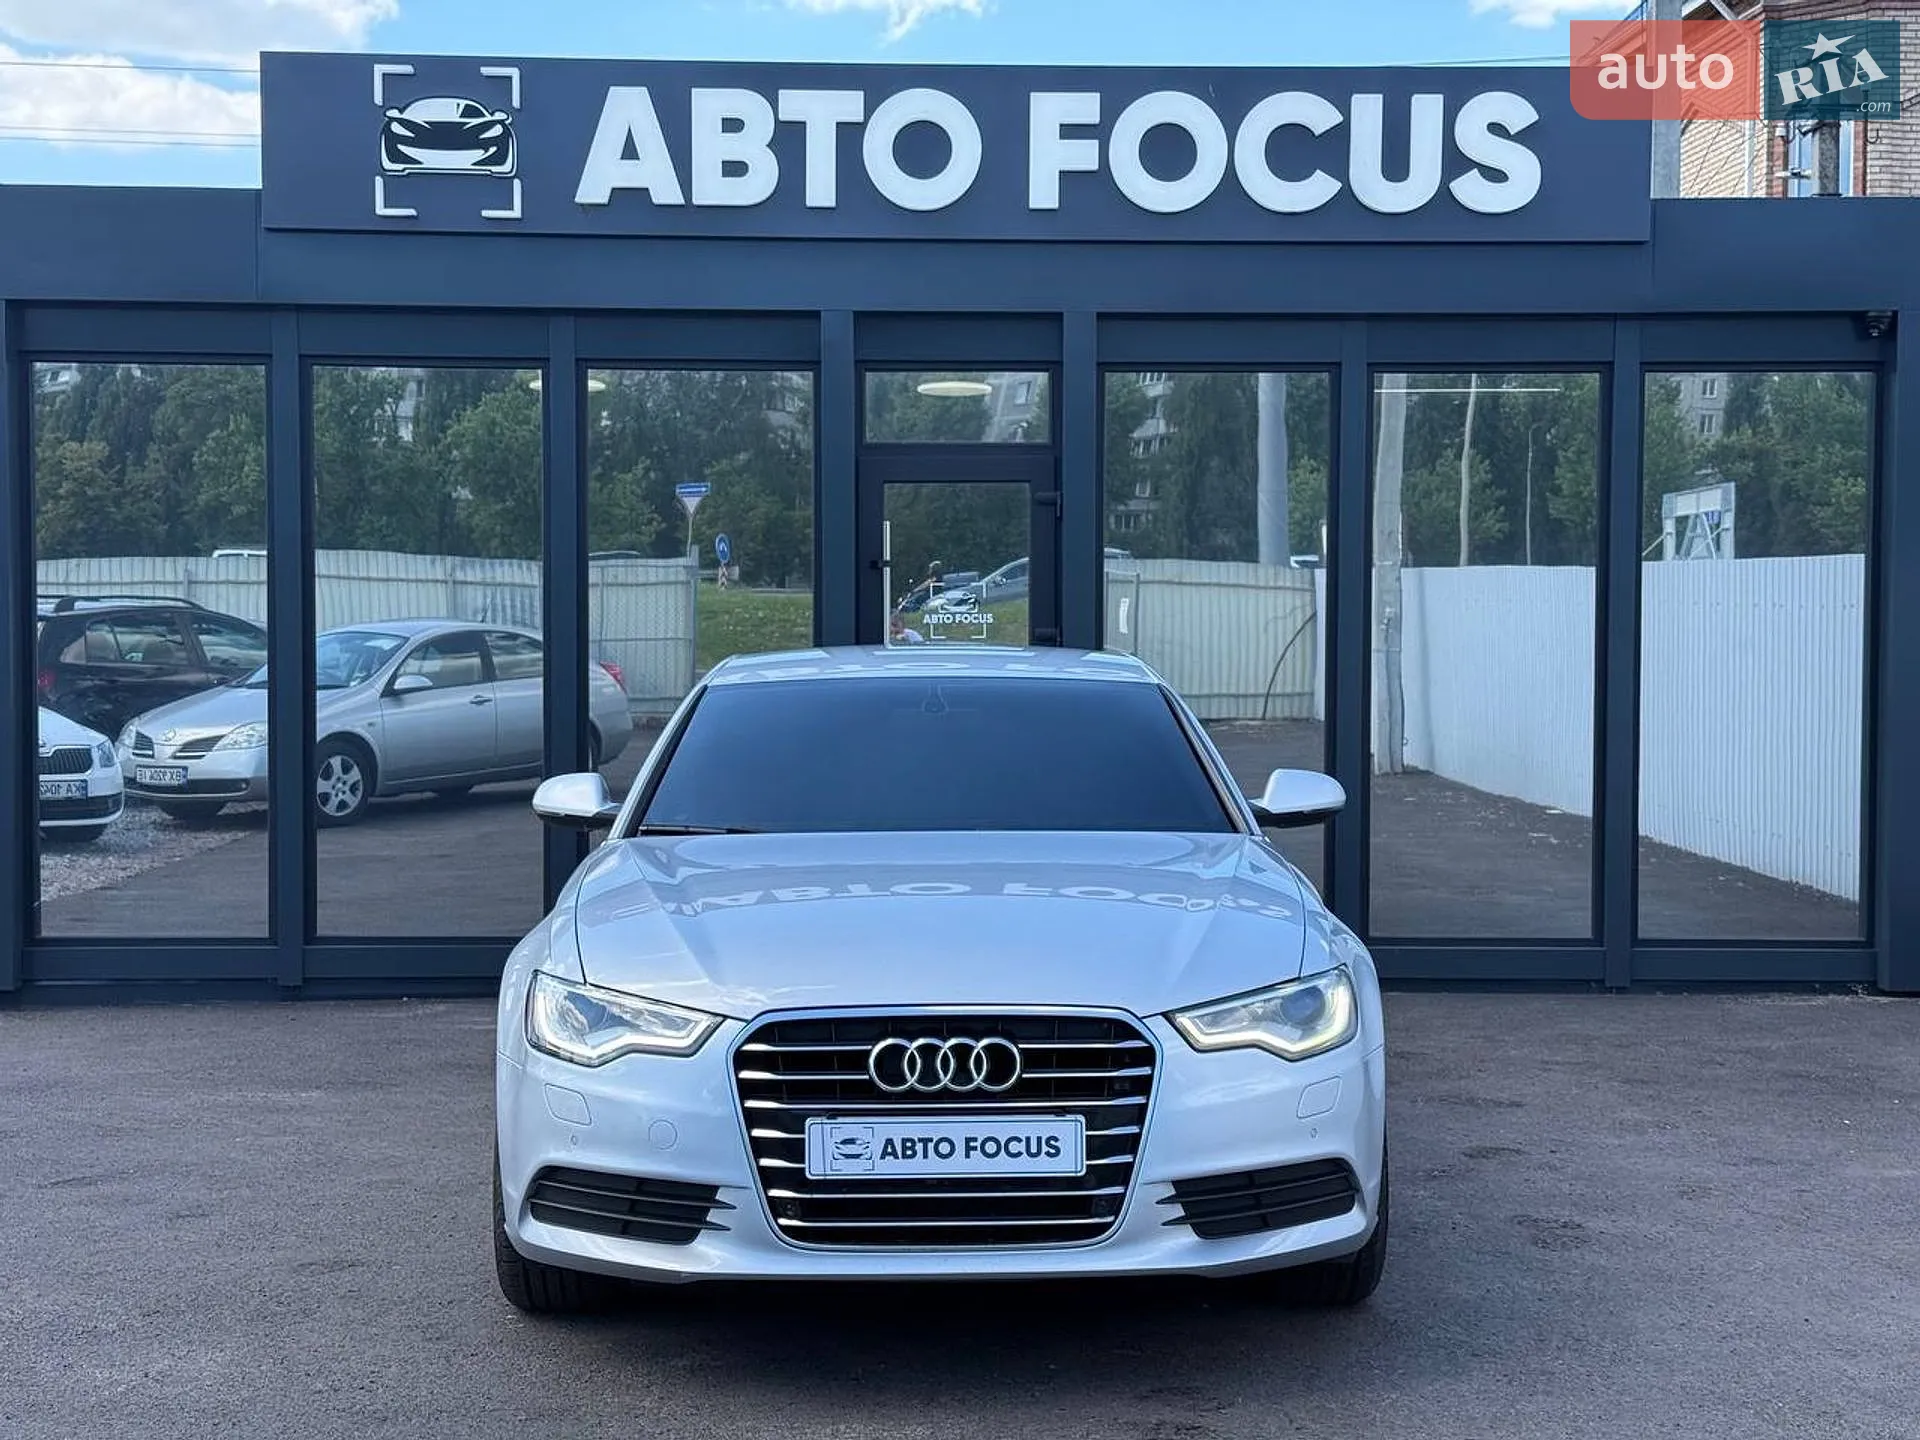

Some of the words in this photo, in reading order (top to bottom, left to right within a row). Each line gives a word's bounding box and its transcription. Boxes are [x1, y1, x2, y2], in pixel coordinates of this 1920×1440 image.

[574, 85, 982, 212] АВТО
[1028, 90, 1542, 215] FOCUS
[923, 613, 953, 624] АВТО
[955, 613, 994, 624] FOCUS
[879, 1135, 957, 1161] АВТО
[964, 1134, 1062, 1160] FOCUS
